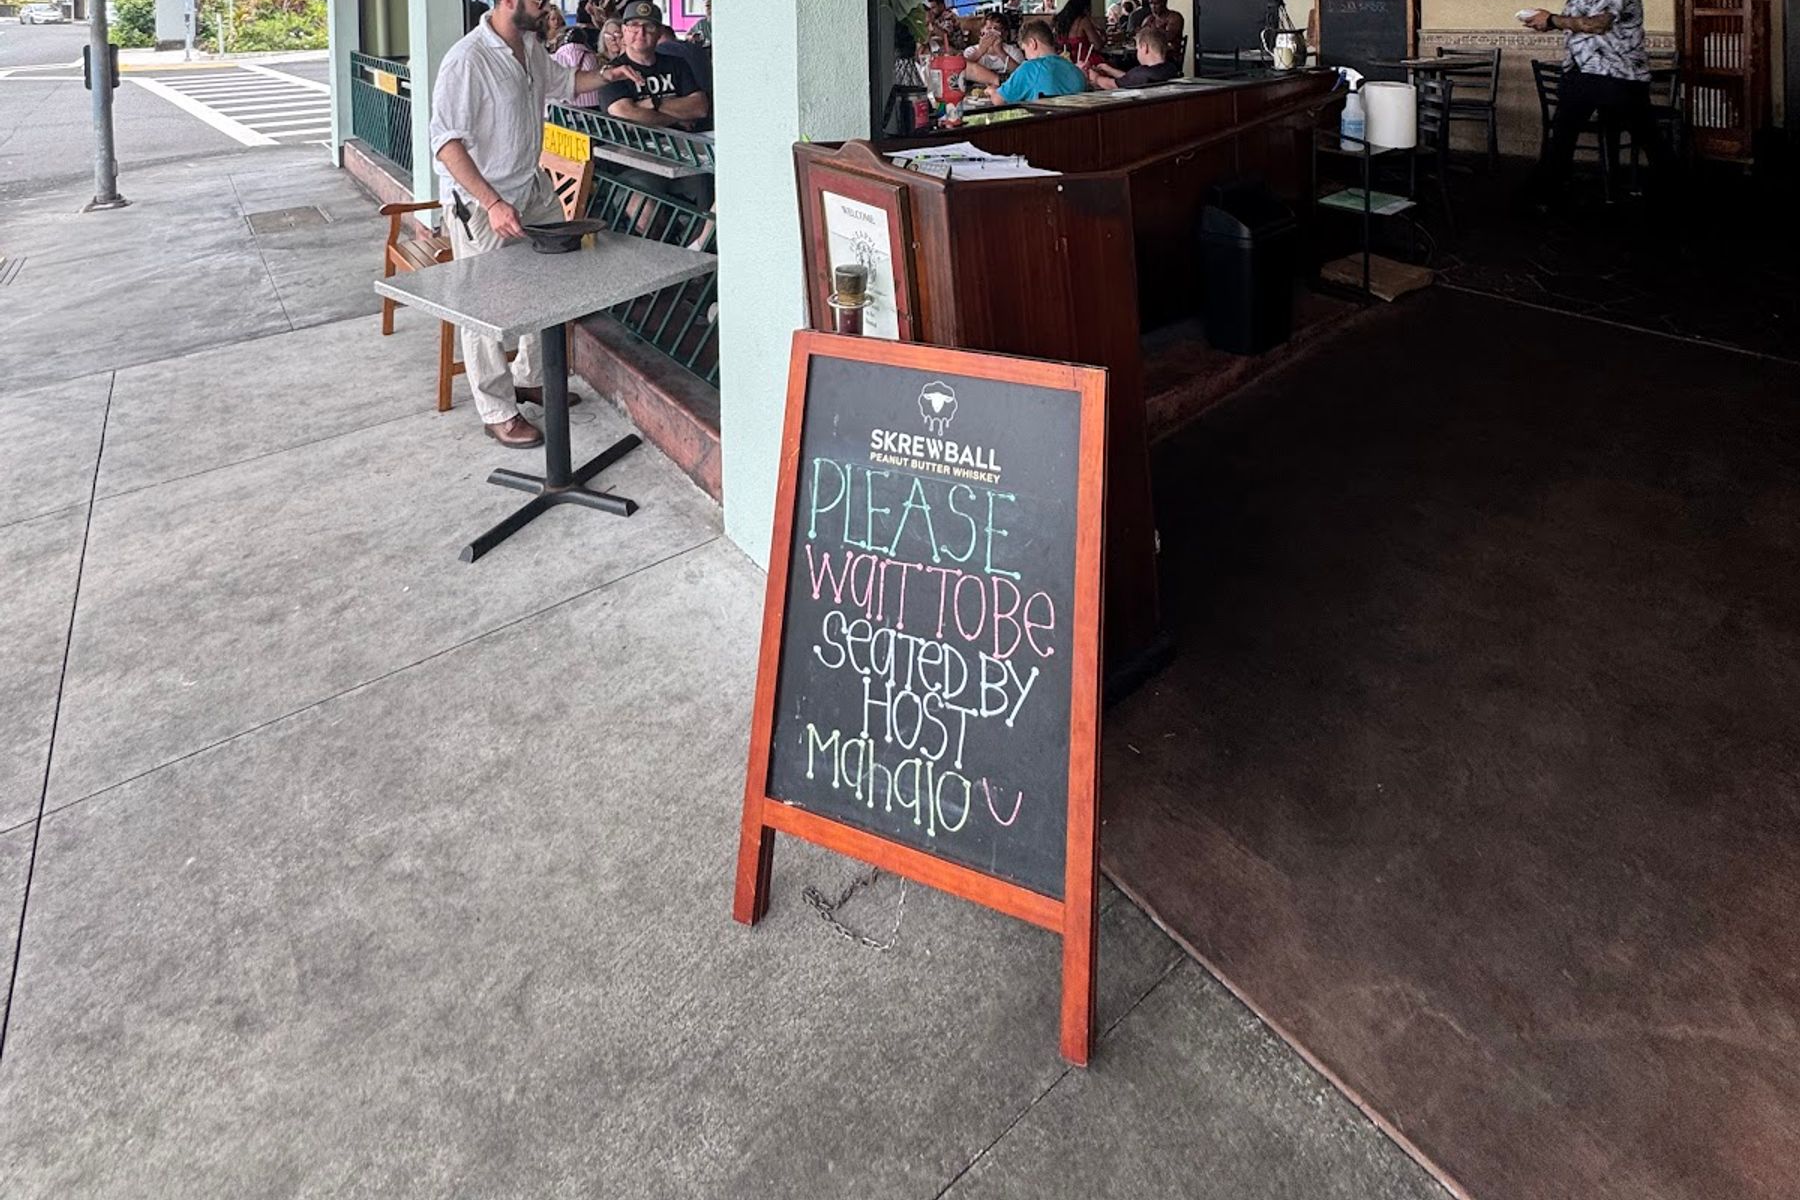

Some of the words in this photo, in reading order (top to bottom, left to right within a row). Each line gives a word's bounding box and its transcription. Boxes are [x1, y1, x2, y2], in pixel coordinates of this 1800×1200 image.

[869, 451, 909, 467] PEANUT
[910, 459, 951, 476] BUTTER
[952, 466, 1001, 484] WHISKEY
[870, 429, 1002, 472] SKREWBALL
[807, 457, 1022, 580] PLEASE
[925, 565, 987, 642] TO
[861, 676, 979, 770] HOST
[978, 651, 1040, 728] BY
